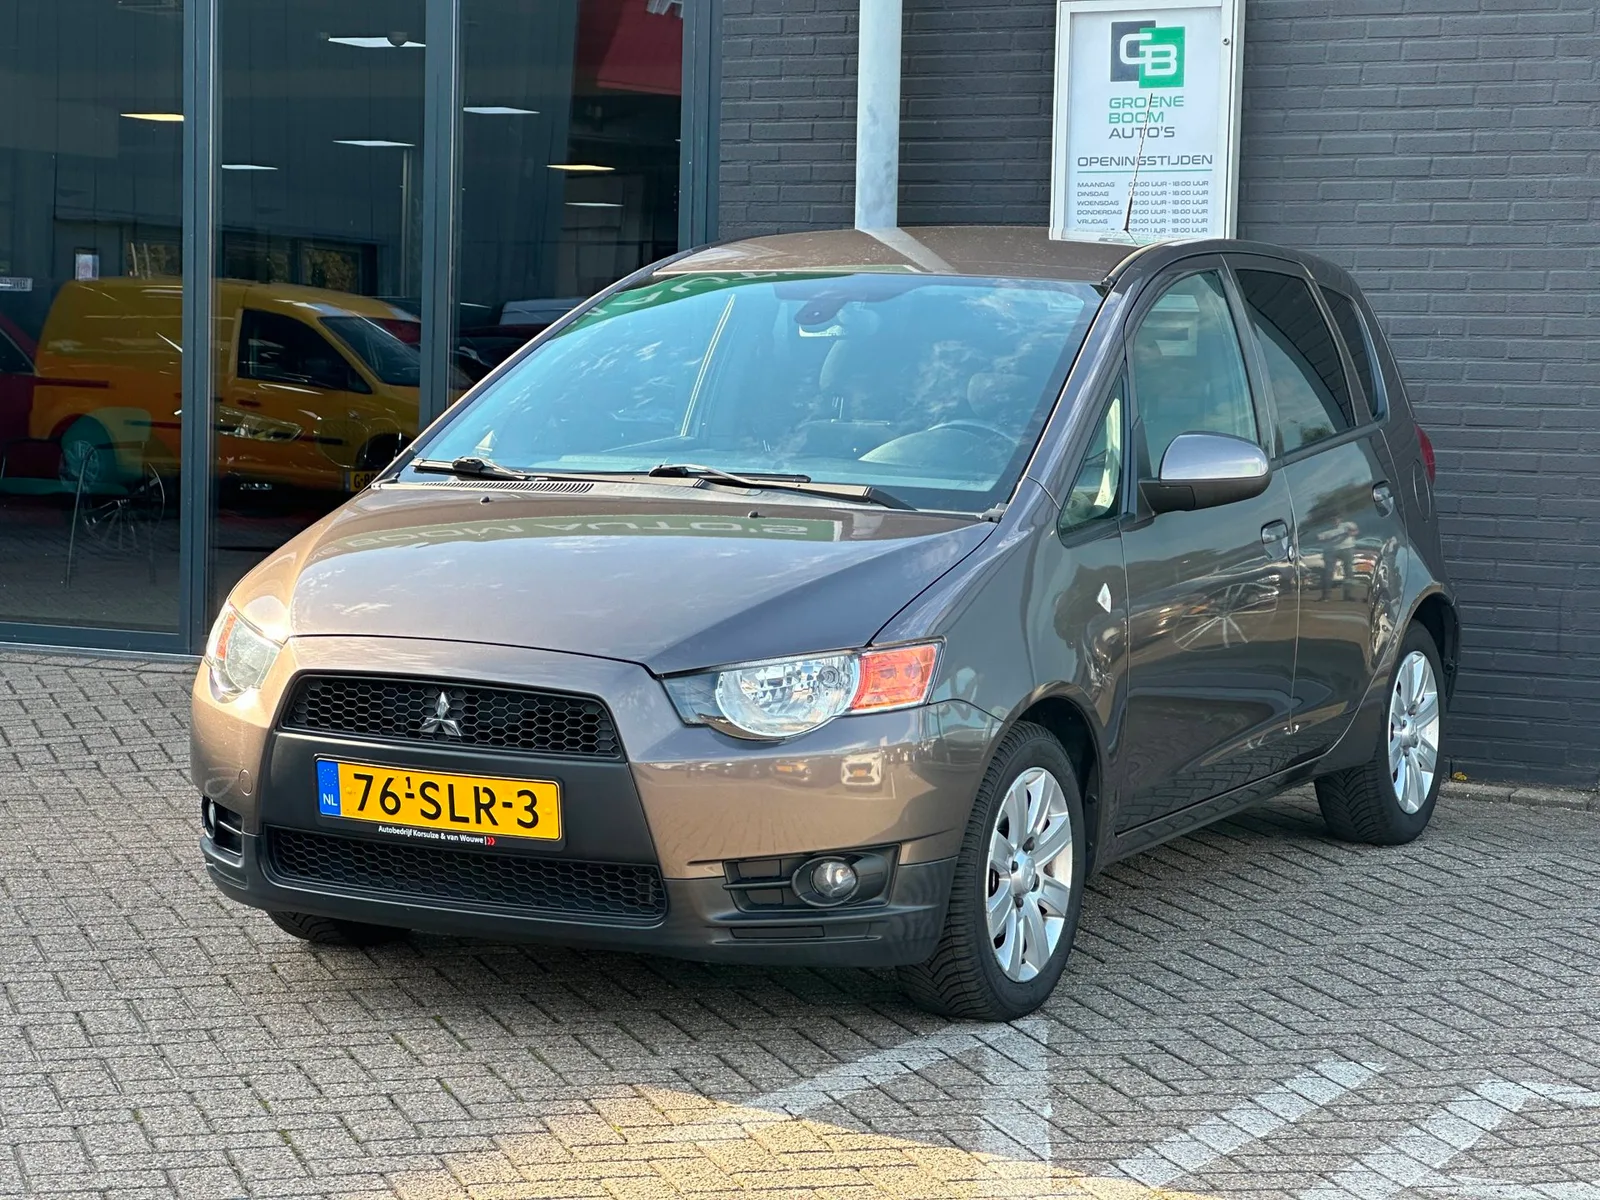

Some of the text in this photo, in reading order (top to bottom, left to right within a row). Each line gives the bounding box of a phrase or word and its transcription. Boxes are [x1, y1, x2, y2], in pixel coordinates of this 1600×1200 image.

[1108, 95, 1185, 109] GROENE
[1108, 111, 1165, 124] BOOM
[1108, 126, 1176, 139] AUTO'S
[1077, 154, 1213, 167] OPENINGSTIJDEN
[323, 793, 338, 807] NL
[378, 825, 412, 837] Autobedrijf
[412, 830, 439, 840] Korsuize
[440, 832, 446, 840] &
[460, 834, 484, 844] Wouwe
